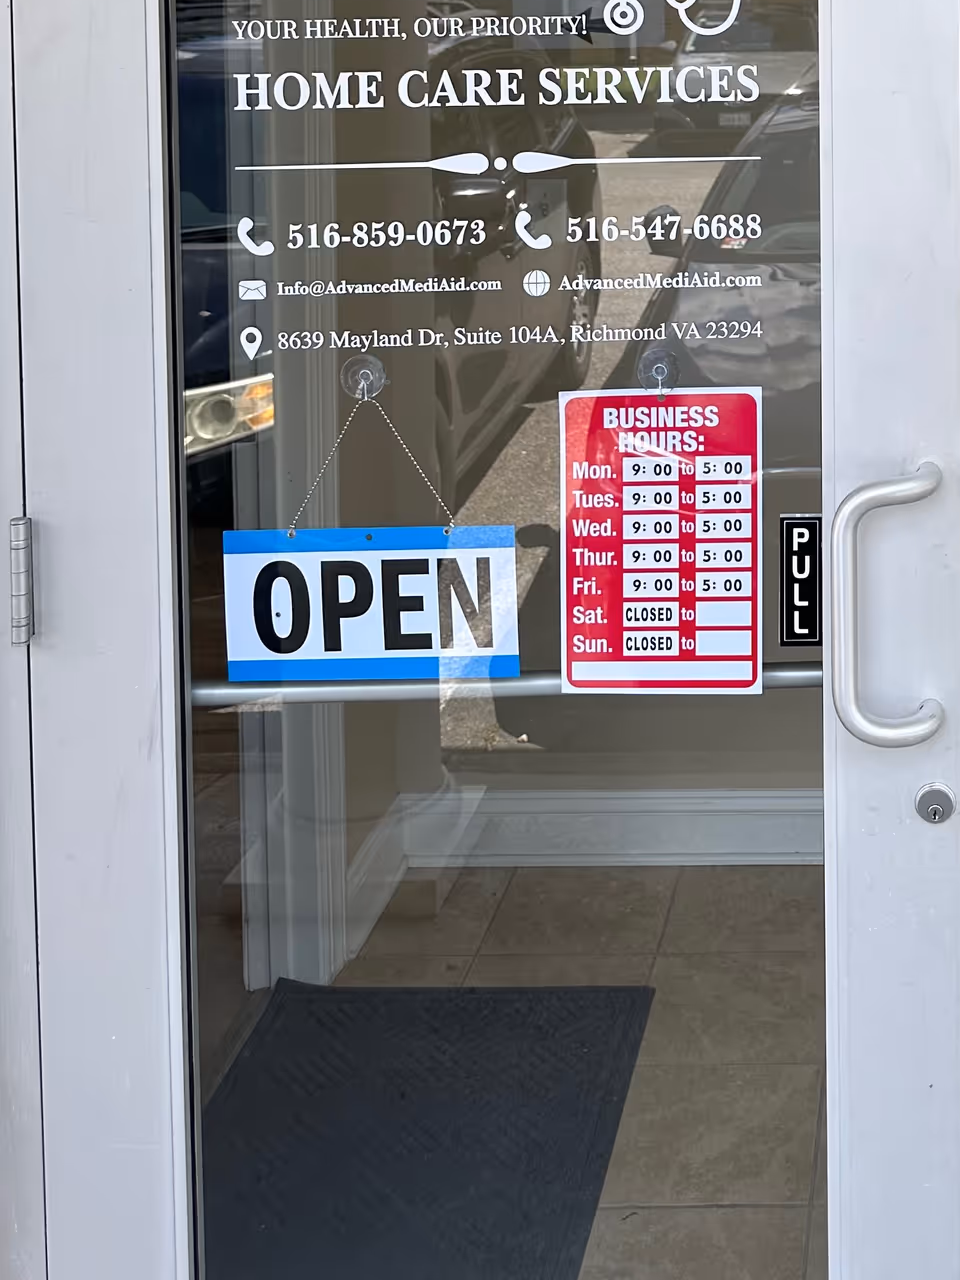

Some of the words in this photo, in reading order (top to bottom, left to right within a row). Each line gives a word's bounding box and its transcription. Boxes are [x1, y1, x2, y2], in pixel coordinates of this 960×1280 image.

[232, 20, 300, 40] YOUR
[304, 19, 407, 40] HEALTH,
[413, 18, 466, 37] OUR
[471, 14, 587, 37] PRIORITY!
[233, 72, 384, 111] HOME
[398, 69, 525, 108] CARE
[538, 64, 760, 104] SERVICES
[287, 219, 486, 249] 516-859-0673
[566, 213, 762, 243] 516-547-6688
[276, 276, 502, 297] Info@AdvancedMediAid.com
[558, 271, 762, 291] AdvancedMediAid.com
[277, 331, 324, 349] 8639
[329, 328, 413, 352] Mayland
[418, 328, 449, 348] Dr,
[454, 327, 502, 346] Suite
[509, 325, 566, 345] 104A,
[570, 324, 667, 343] Richmond
[671, 322, 702, 339] VA
[705, 320, 764, 339] 23294
[603, 406, 719, 429] BUSINESS
[618, 431, 705, 452] HOURS:
[572, 461, 617, 479] Mon.
[681, 462, 694, 476] to
[572, 490, 619, 508] Tues.
[681, 491, 694, 504] to
[572, 519, 617, 537] Wed.
[681, 520, 694, 533] to
[572, 548, 617, 566] Thur.
[681, 549, 694, 562] to
[572, 577, 602, 595] Fri.
[681, 578, 694, 591] to
[792, 527, 811, 635] PULL
[253, 556, 494, 654] OPEN
[572, 606, 608, 624] Sat.
[625, 607, 673, 622] CLOSED
[681, 607, 694, 621] to
[572, 635, 613, 653] Sun.
[625, 636, 673, 651] CLOSED
[681, 636, 694, 650] to
